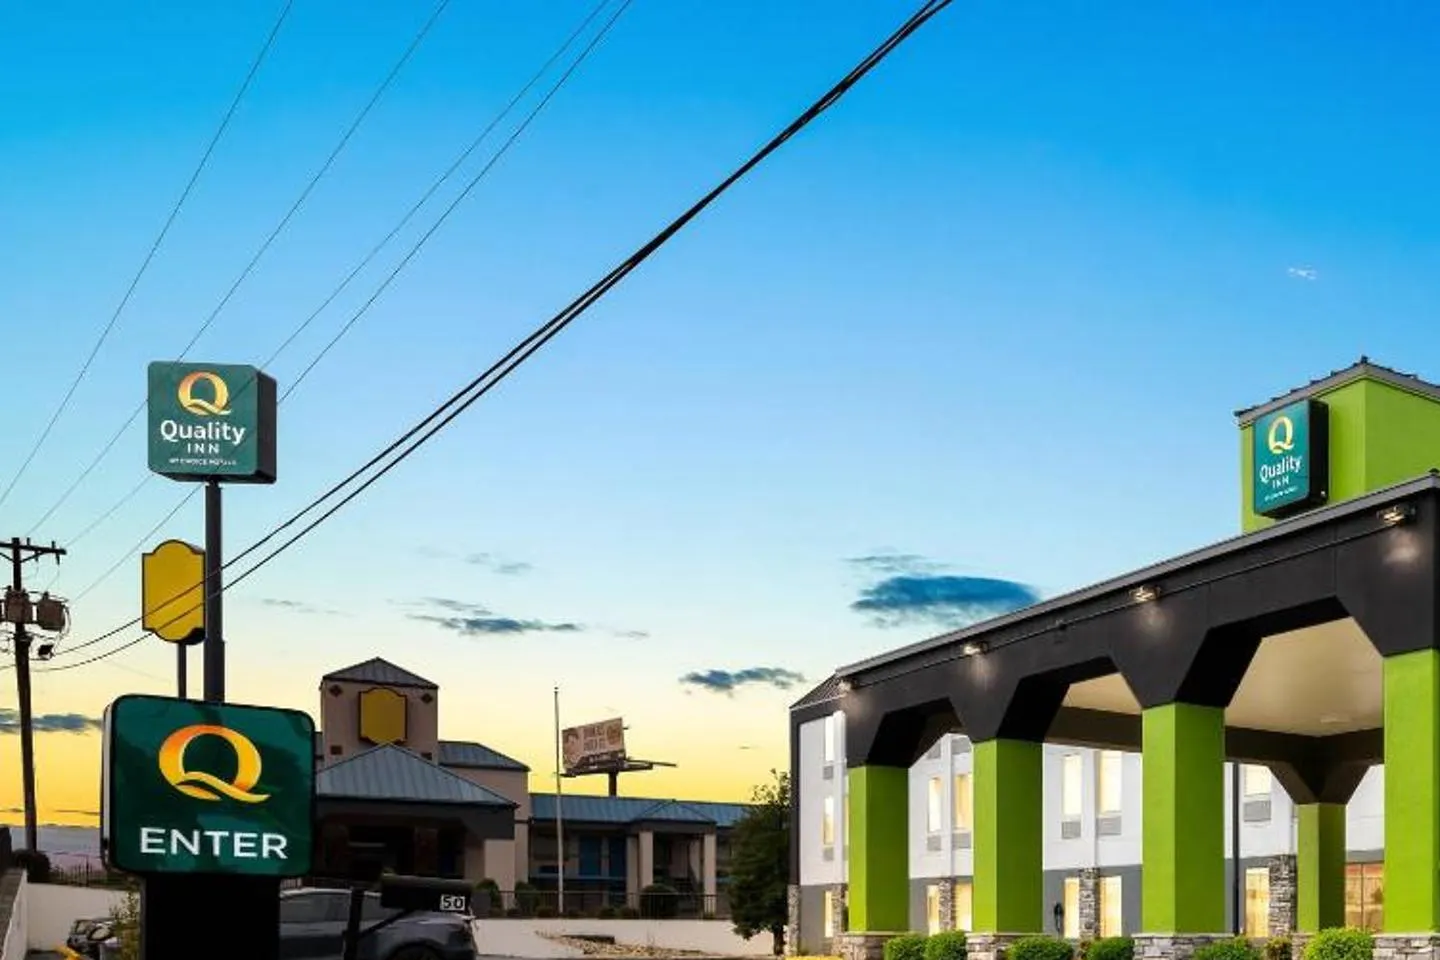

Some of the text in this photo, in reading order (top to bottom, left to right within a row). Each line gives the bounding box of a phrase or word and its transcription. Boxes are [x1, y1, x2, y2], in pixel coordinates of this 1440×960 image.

[178, 371, 231, 415] Q
[160, 419, 246, 445] Quality
[186, 442, 220, 454] INN
[1268, 415, 1295, 454] Q
[1260, 455, 1303, 484] Quality
[158, 723, 271, 804] Q
[139, 826, 289, 860] ENTER
